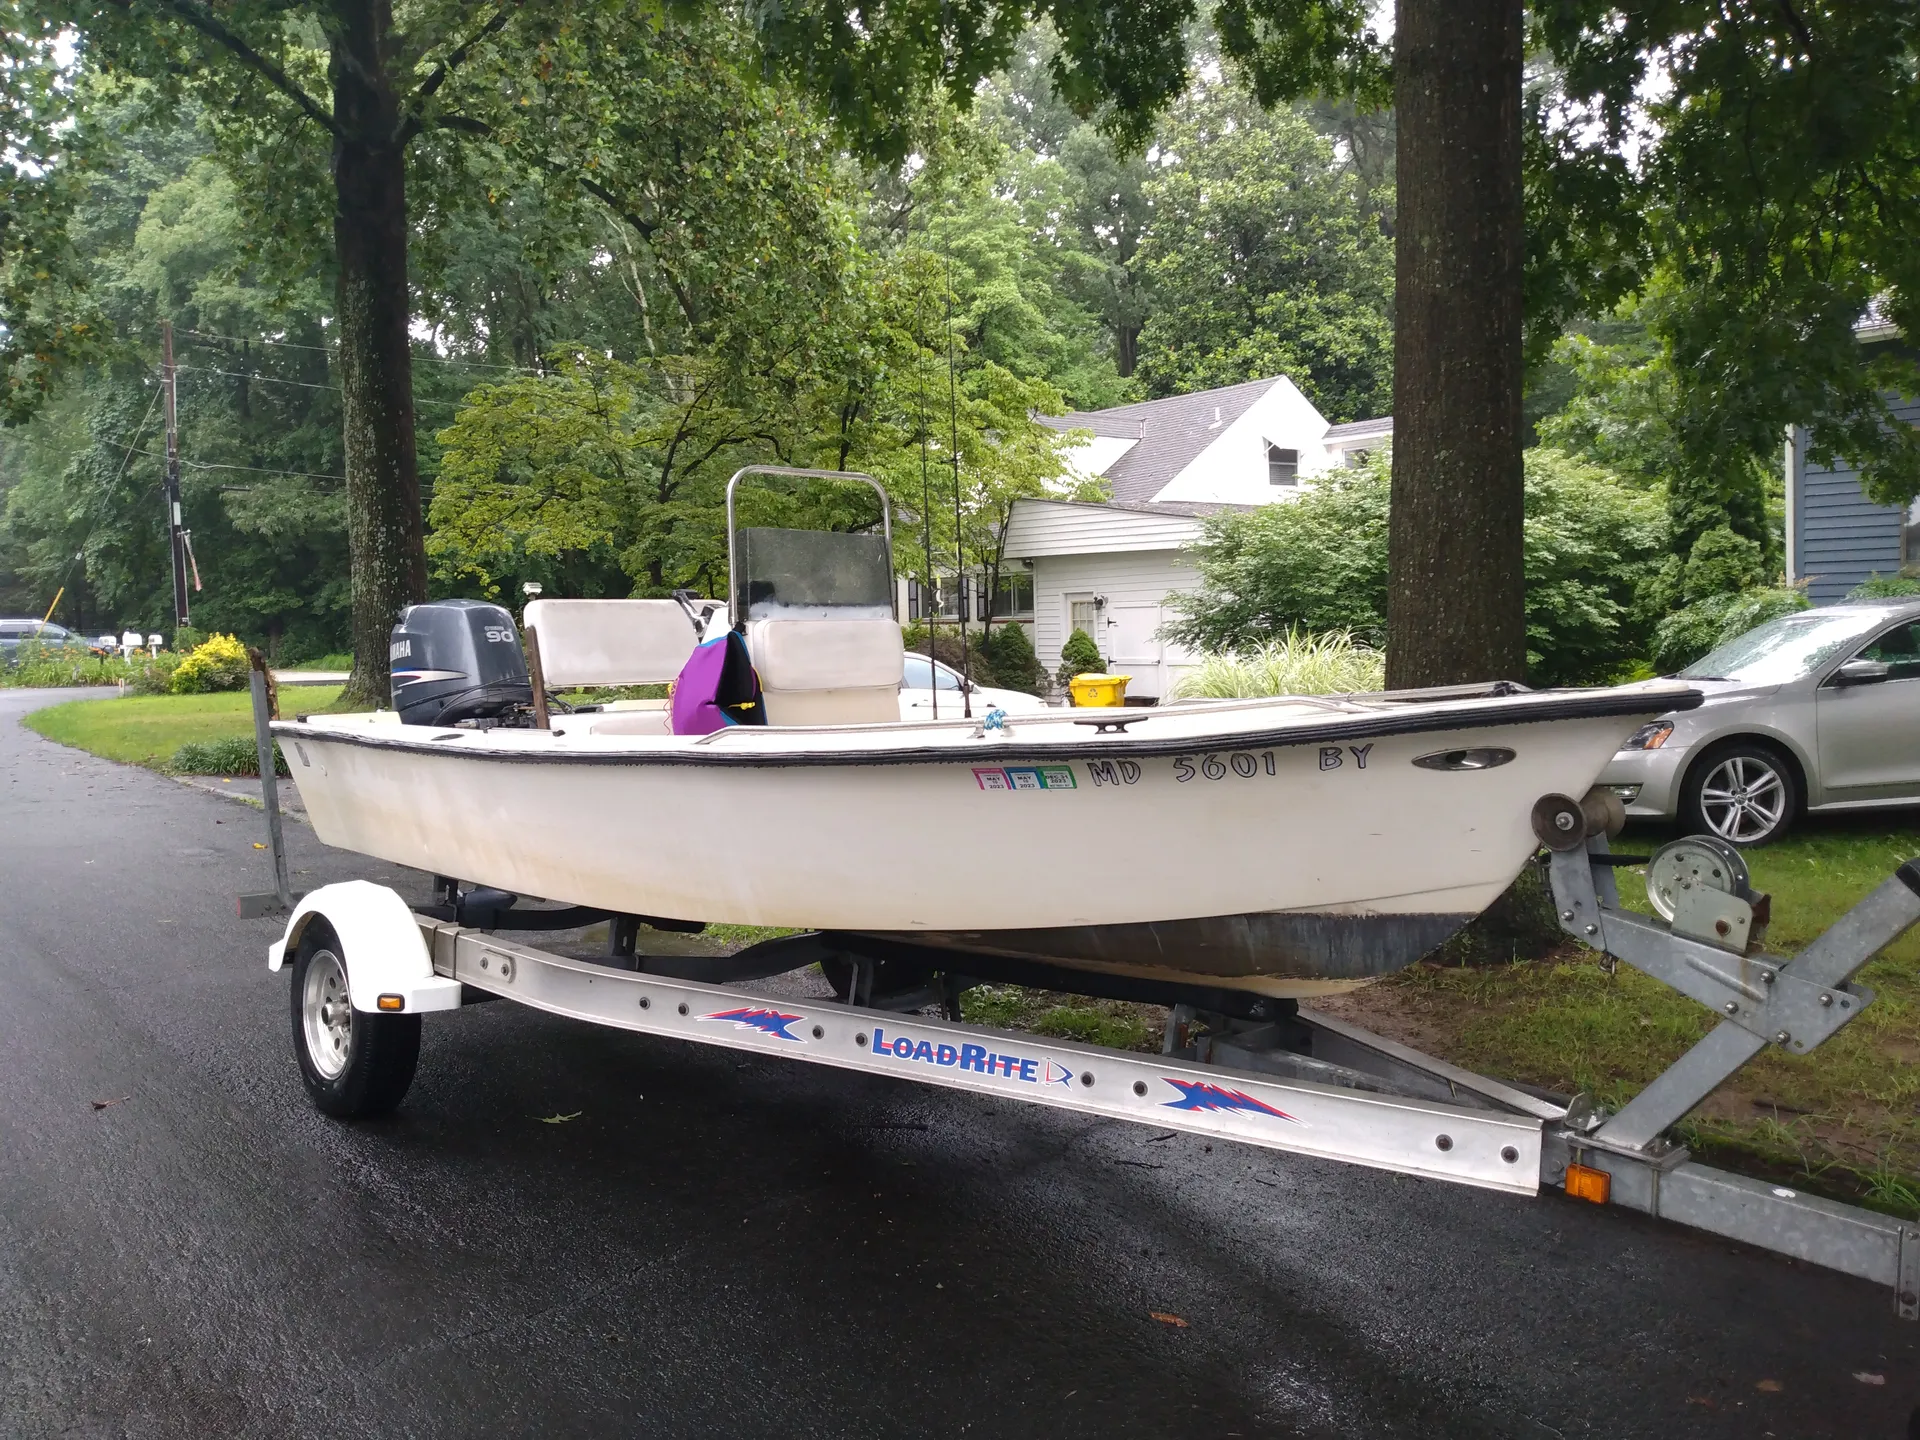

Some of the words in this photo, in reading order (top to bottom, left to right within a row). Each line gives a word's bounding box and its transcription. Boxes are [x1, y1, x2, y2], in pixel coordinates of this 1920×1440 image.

[486, 631, 514, 643] 90
[1087, 760, 1141, 787] MD
[1172, 751, 1276, 782] 5601
[1319, 743, 1375, 771] BY
